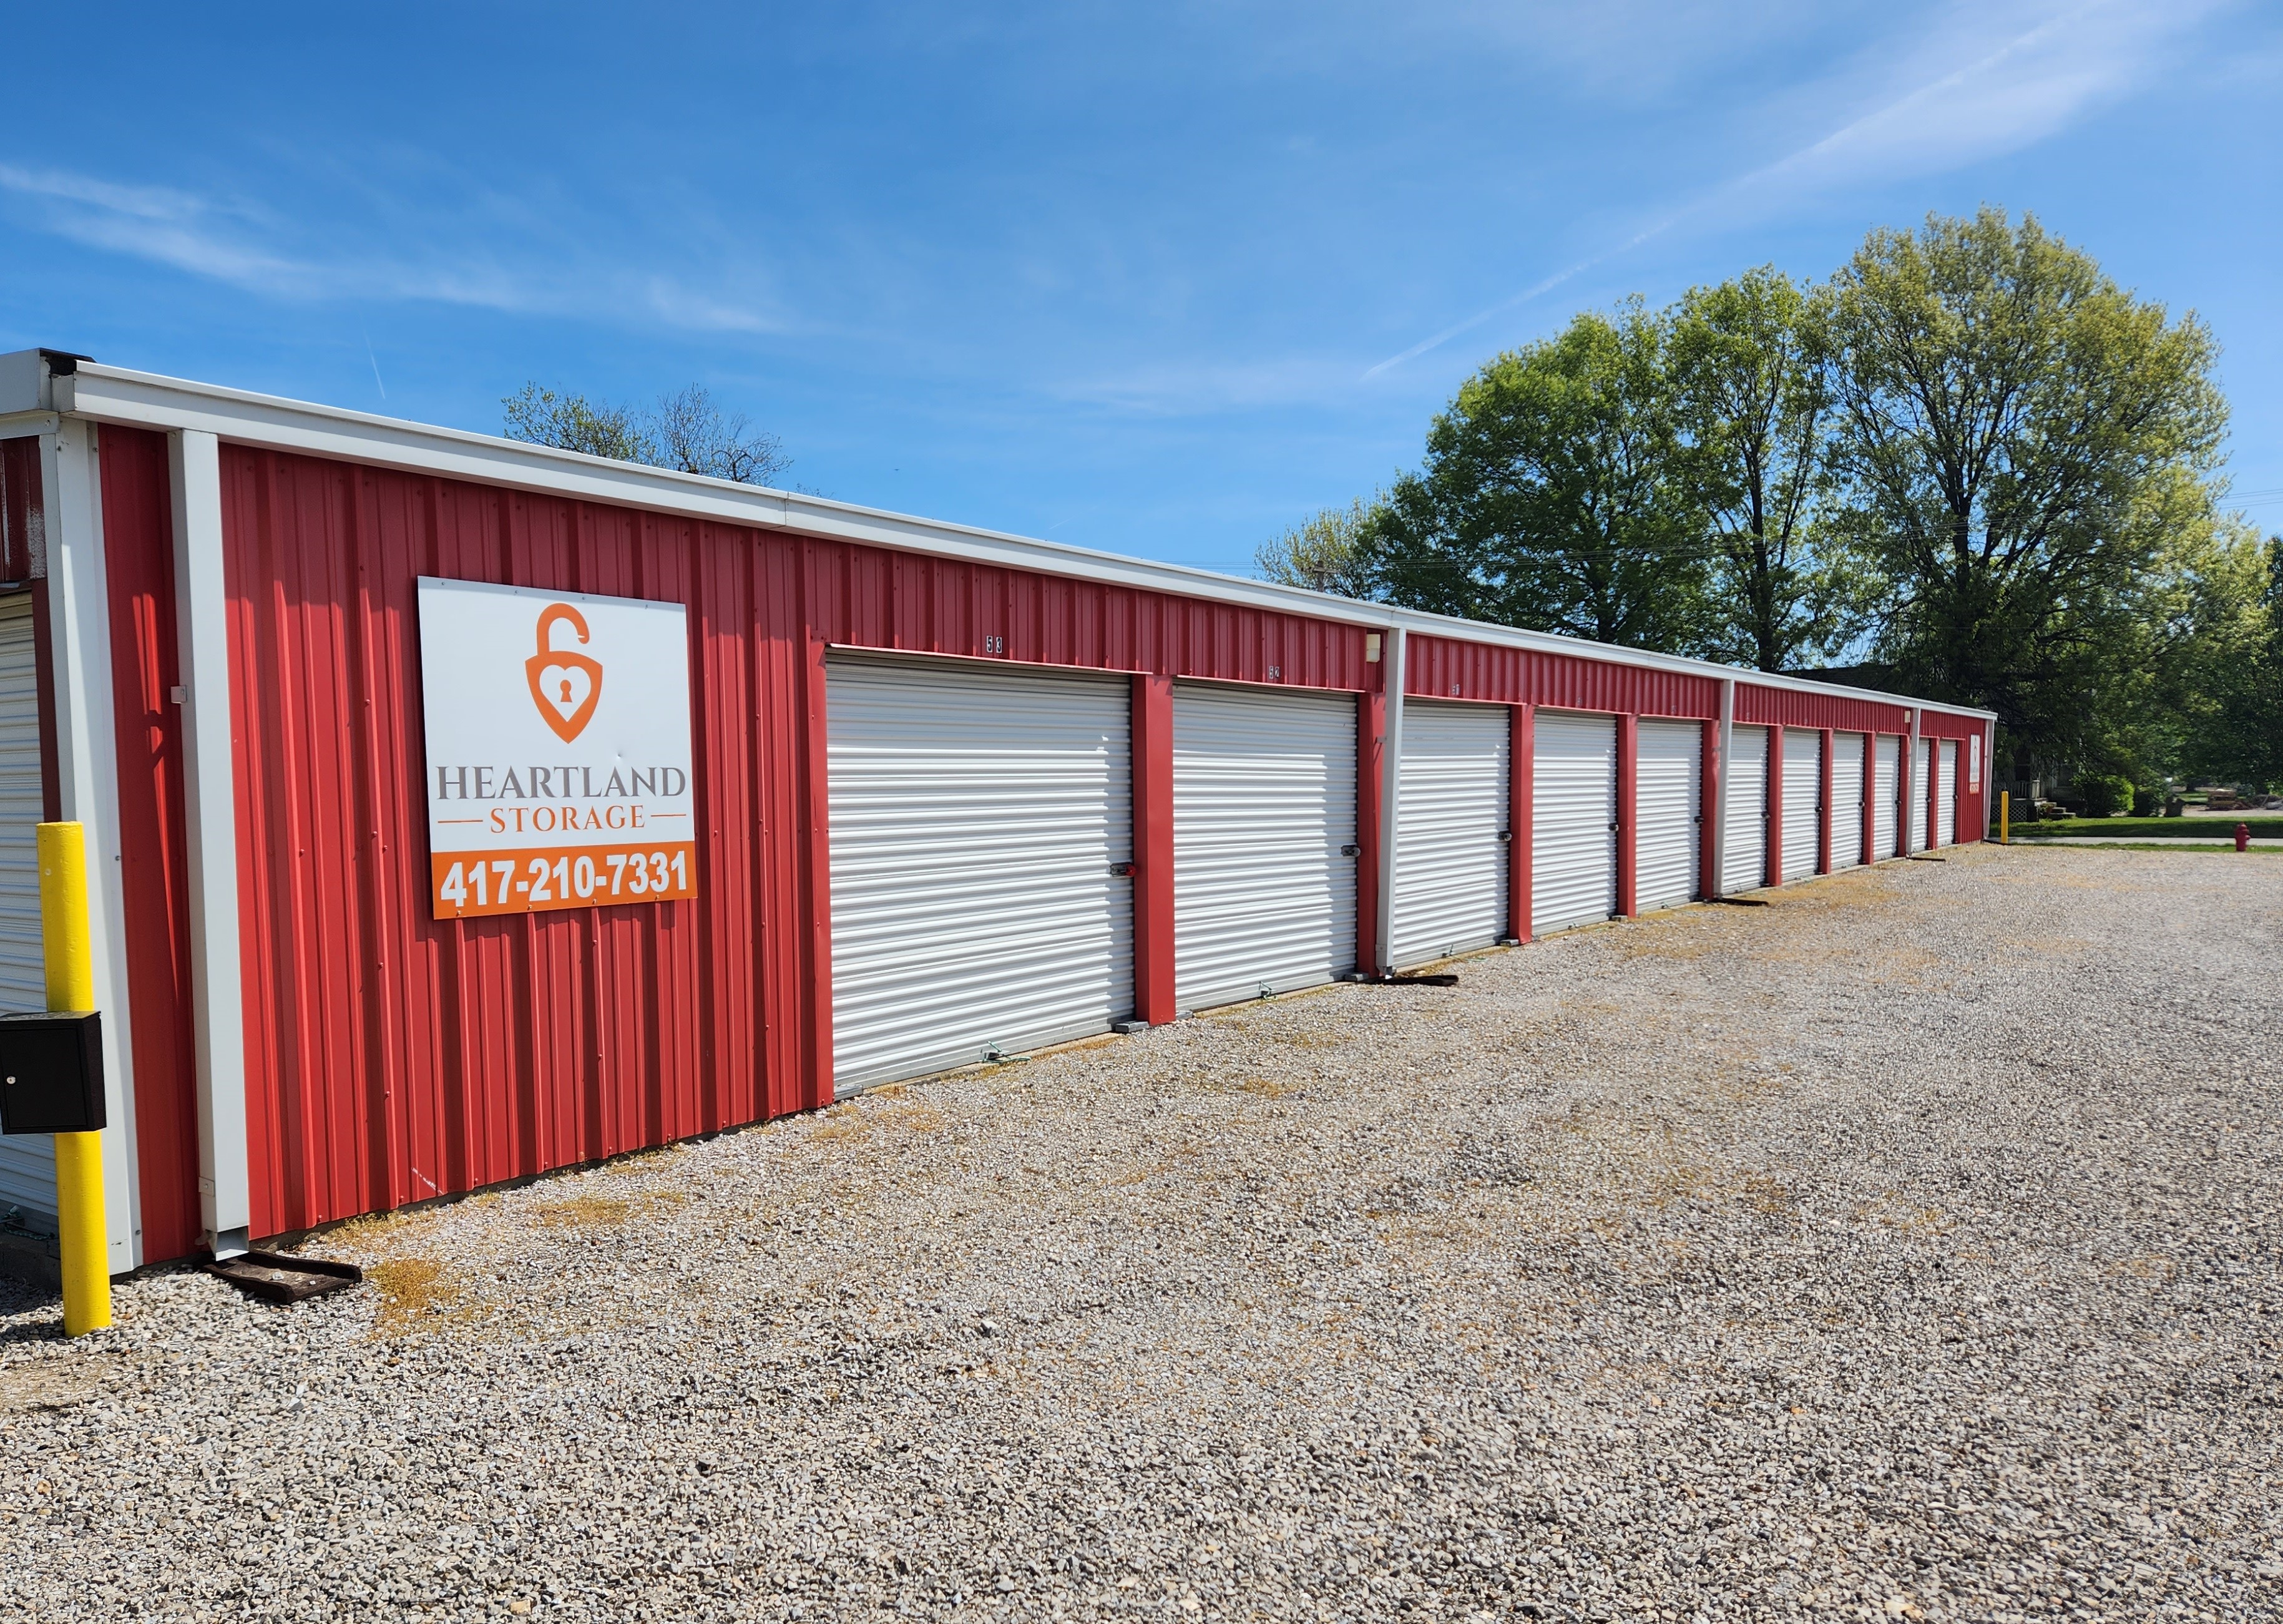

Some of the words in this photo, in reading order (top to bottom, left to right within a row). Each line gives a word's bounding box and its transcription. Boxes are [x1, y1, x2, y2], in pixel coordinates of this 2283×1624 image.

[987, 636, 1002, 653] 53
[436, 766, 686, 800] HEARTLAND
[491, 805, 645, 833] STORAGE
[441, 851, 687, 907] 417-210-7331
